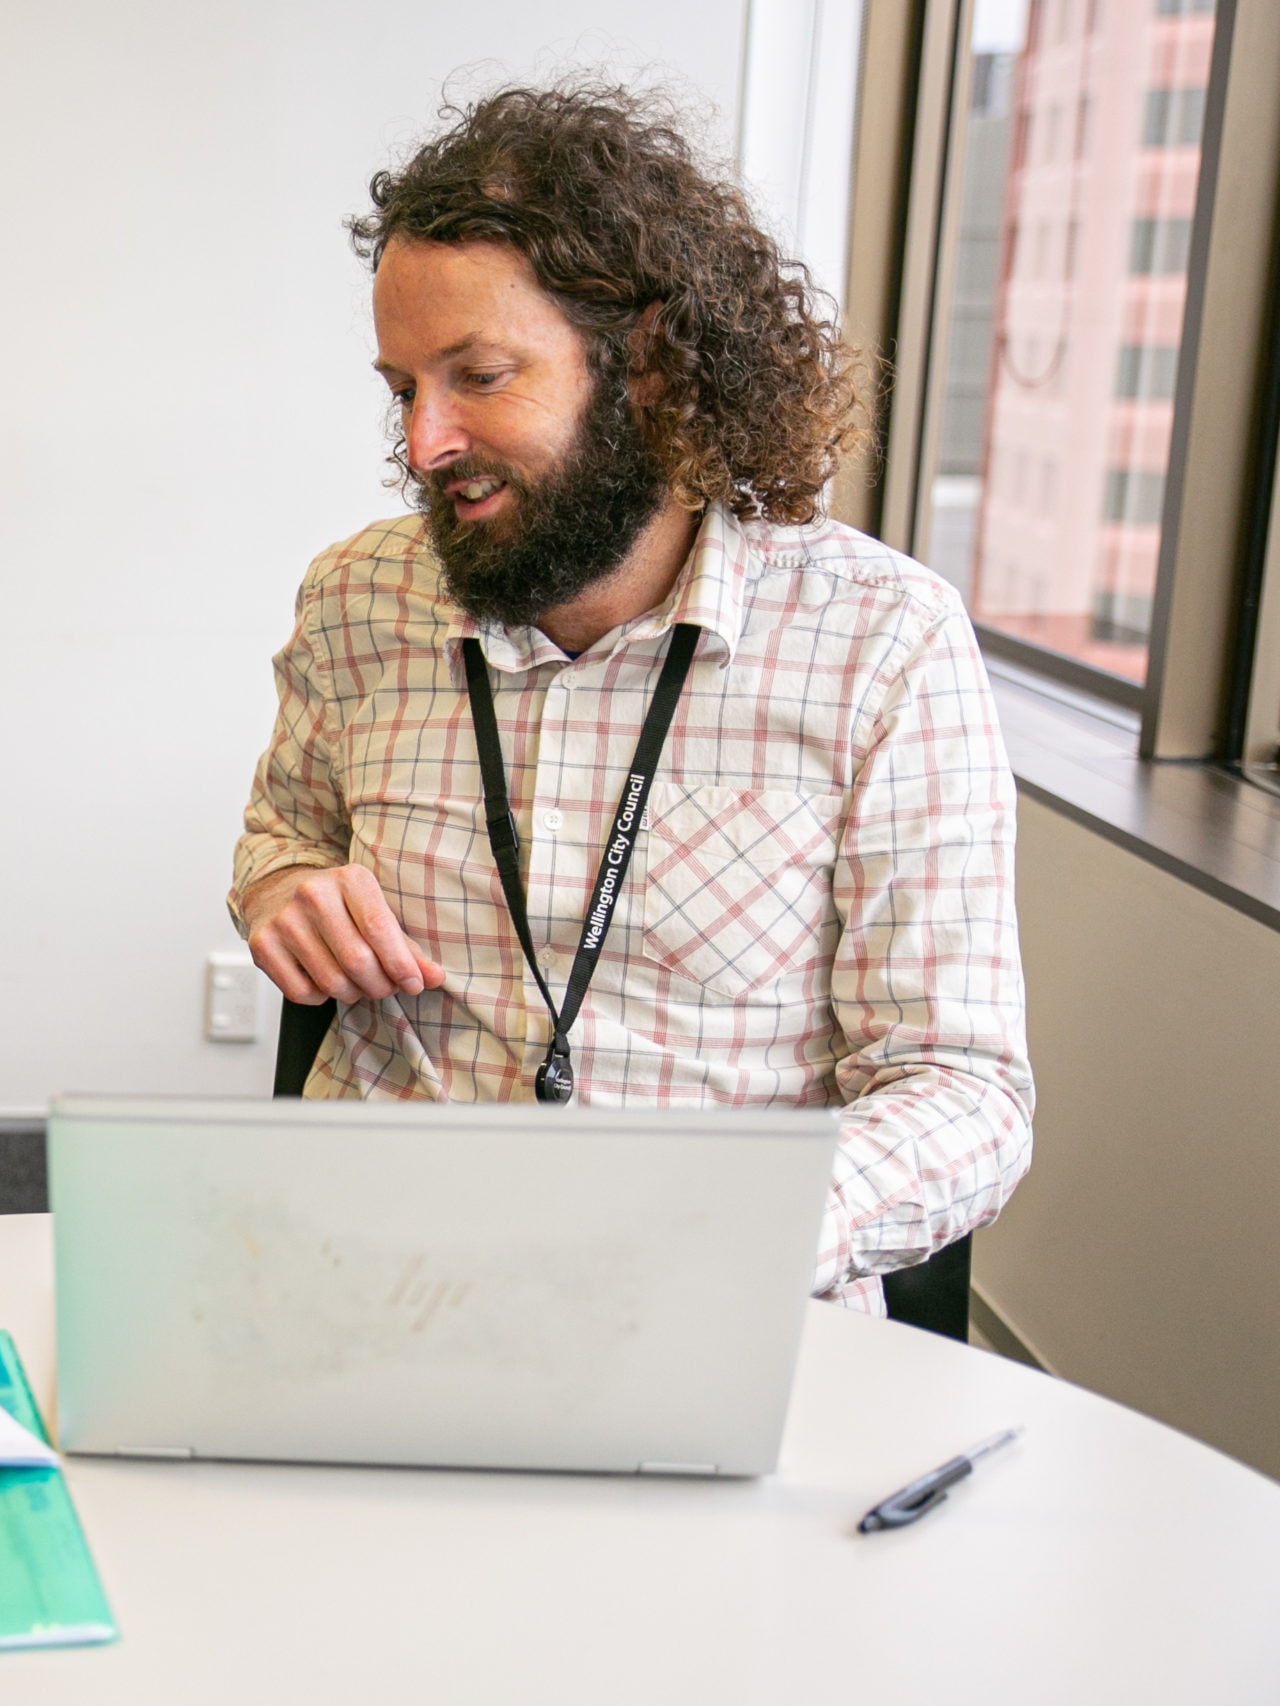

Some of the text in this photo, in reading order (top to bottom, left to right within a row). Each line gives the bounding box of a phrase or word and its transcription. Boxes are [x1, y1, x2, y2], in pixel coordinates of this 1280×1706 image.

[583, 775, 645, 949] Wellington City Council
